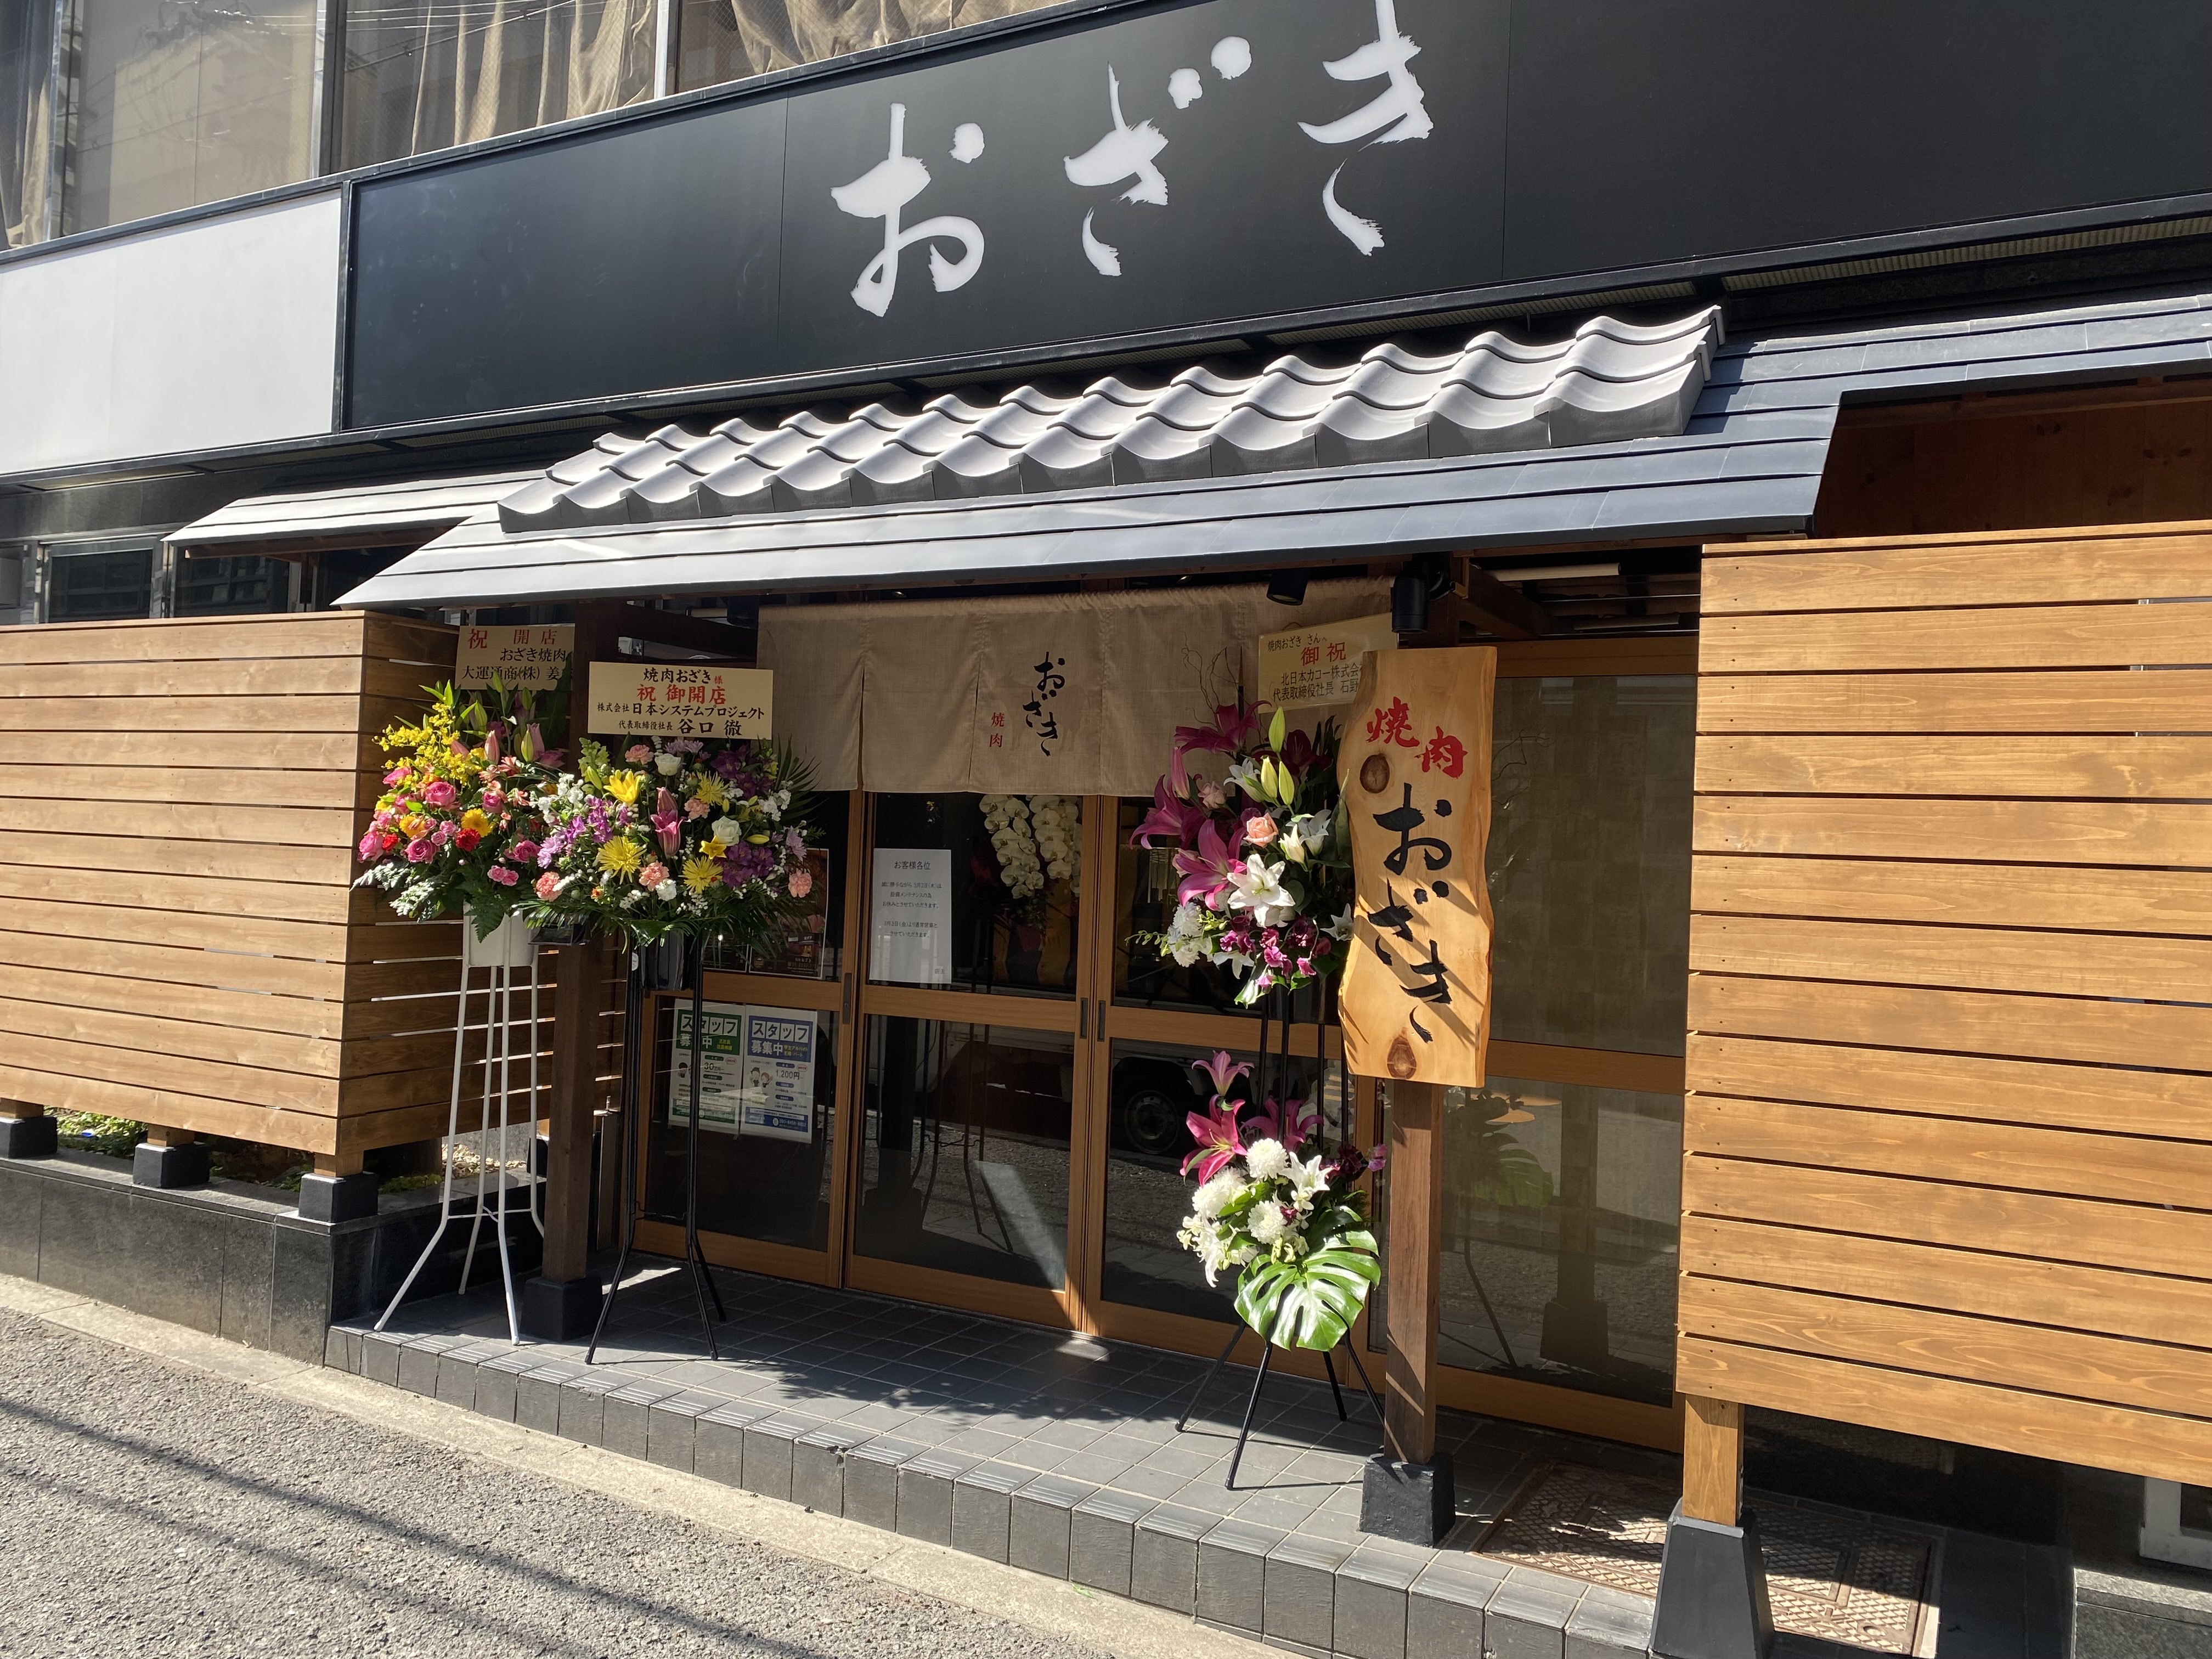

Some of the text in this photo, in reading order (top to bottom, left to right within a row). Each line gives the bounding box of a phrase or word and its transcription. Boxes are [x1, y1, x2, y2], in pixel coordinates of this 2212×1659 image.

[831, 0, 1434, 317] おざき
[467, 628, 557, 649] 祝 開店
[1268, 633, 1328, 652] 焼肉おざき さんへ
[500, 647, 566, 662] おざき焼肉
[1300, 642, 1347, 667] 御祝
[636, 684, 727, 705] 祝 御開店
[1273, 681, 1334, 702] 代表取締役社長
[1023, 651, 1065, 757] おざき
[677, 719, 713, 734] 谷口
[989, 712, 1005, 748] 焼肉
[894, 860, 931, 870] お客様各位
[1367, 783, 1453, 1043] おざき
[680, 1034, 713, 1049] 募中
[753, 1022, 808, 1040] スタッフ
[751, 1040, 783, 1056] 募集中
